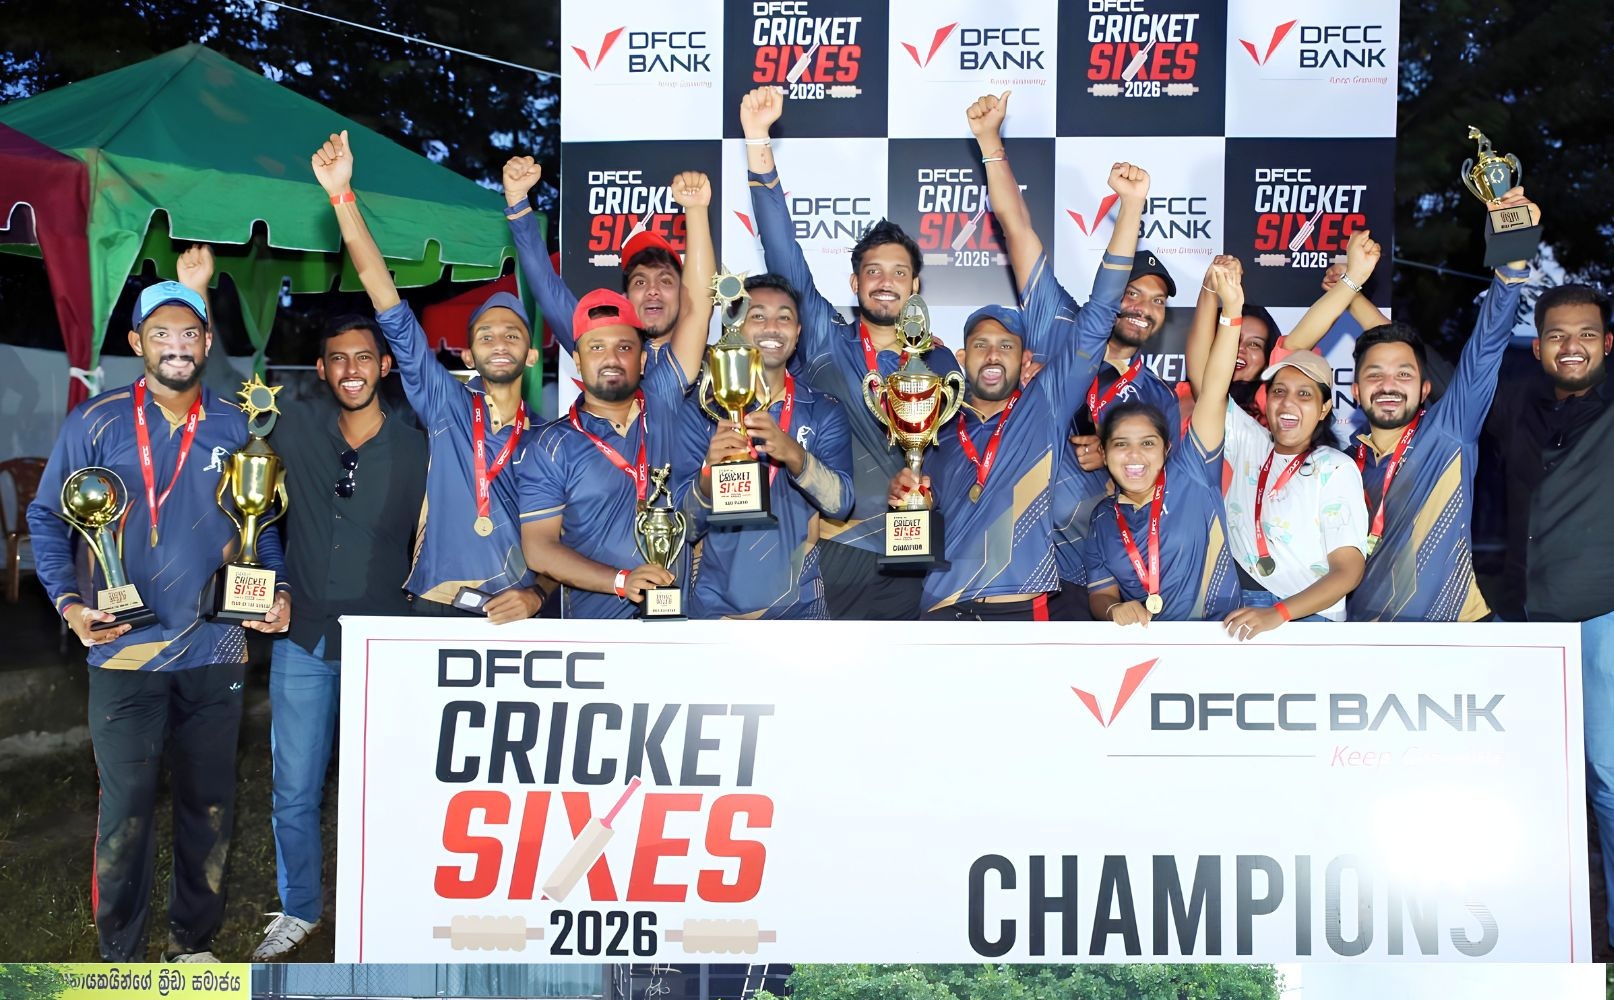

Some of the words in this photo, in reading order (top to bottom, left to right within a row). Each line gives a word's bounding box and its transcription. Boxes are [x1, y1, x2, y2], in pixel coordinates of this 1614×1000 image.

[753, 1, 808, 16] DFCC
[1088, 0, 1144, 12] DFCC
[752, 17, 862, 46] CRICKET
[961, 28, 1040, 46] DFCC
[1088, 14, 1199, 43] CRICKET
[1300, 25, 1382, 44] DFCC
[629, 31, 706, 49] DFCC
[628, 53, 711, 73] BANK
[752, 45, 862, 84] SIXES
[960, 50, 1045, 70] BANK
[1087, 42, 1199, 81] SIXES
[1300, 48, 1387, 68] BANK
[789, 84, 825, 100] 2026
[1124, 82, 1161, 98] 2026
[588, 171, 642, 185] DFCC
[918, 169, 973, 183] DFCC
[1255, 169, 1312, 183] DFCC
[588, 186, 687, 215] CRICKE
[792, 198, 871, 215] DFCC
[1255, 185, 1367, 213] CRICKET
[1254, 213, 1367, 250] SIXES
[954, 251, 990, 267] 2026
[1291, 252, 1328, 268] 2026
[437, 648, 605, 690] DFCC
[1150, 693, 1317, 731] DFCC
[1330, 693, 1506, 733] BANK
[435, 700, 775, 787] CRICKET
[433, 790, 774, 902] SIXES
[549, 909, 658, 957] 2026
